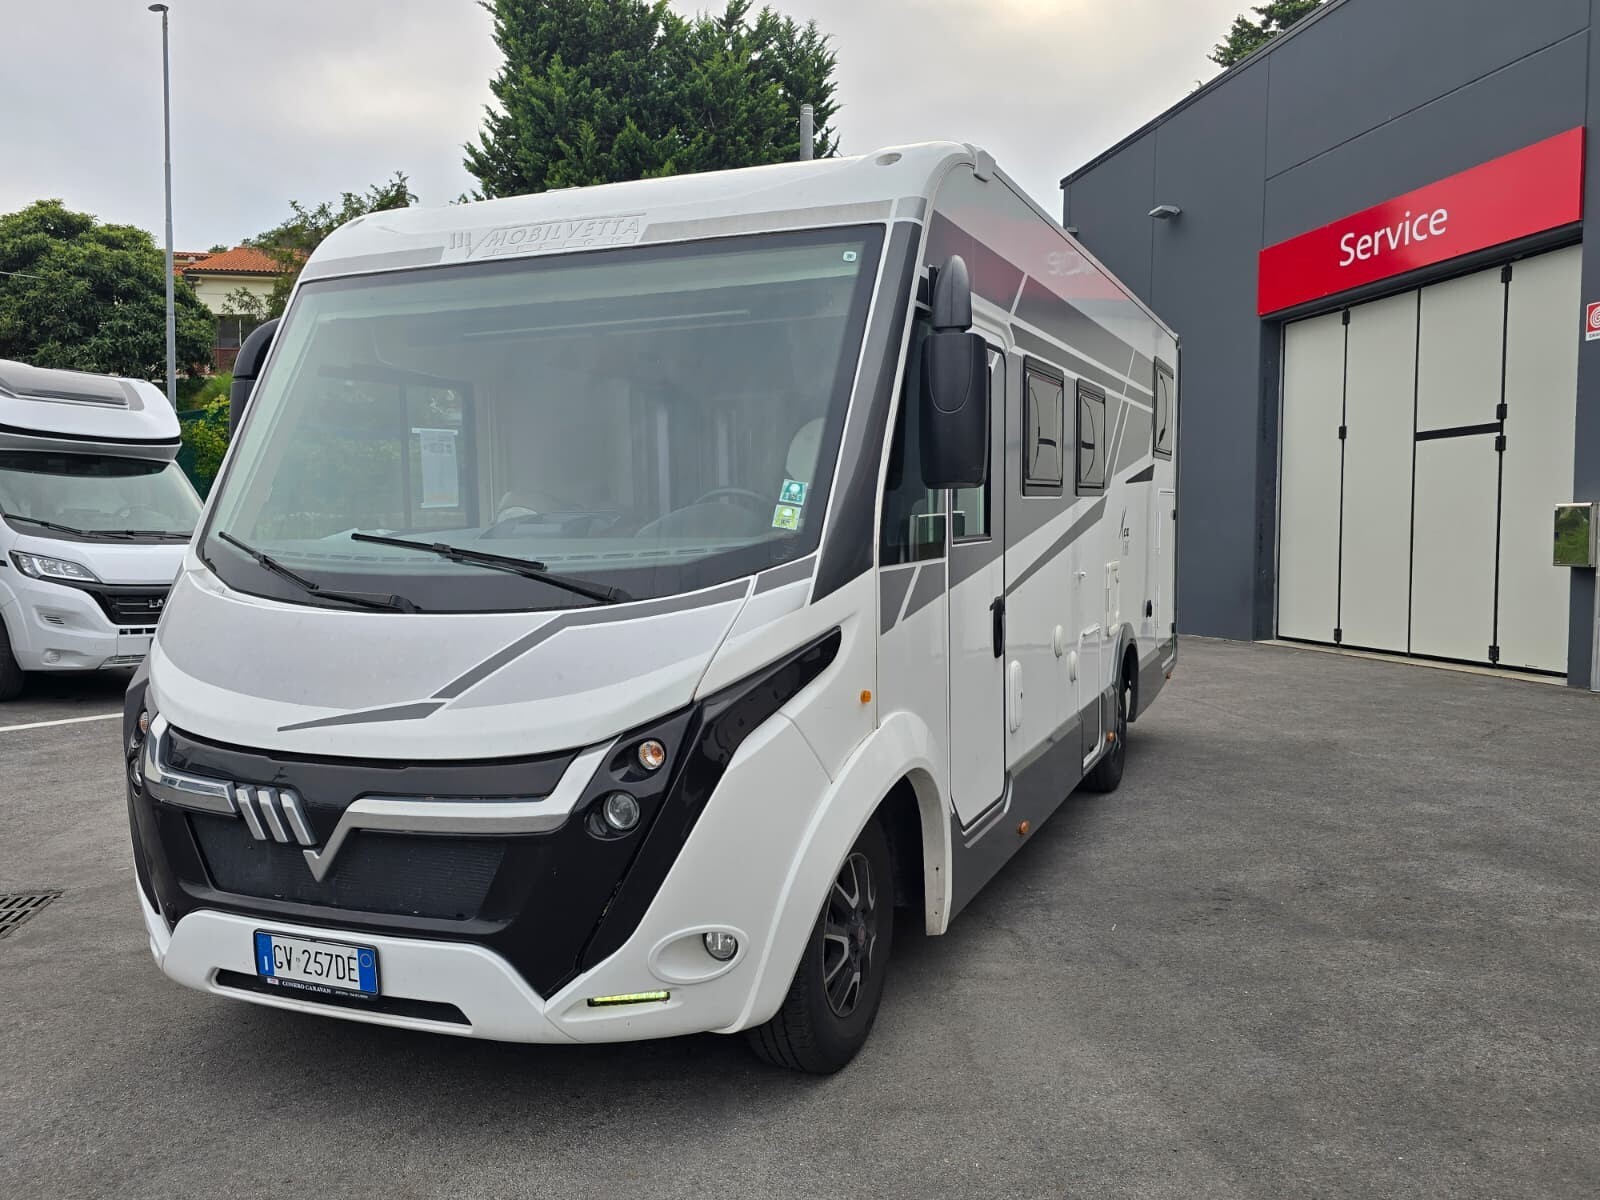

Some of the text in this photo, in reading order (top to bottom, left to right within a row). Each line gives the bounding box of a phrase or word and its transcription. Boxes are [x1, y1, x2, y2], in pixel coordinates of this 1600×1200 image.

[485, 218, 640, 249] MOBILVETTA
[1339, 208, 1448, 267] Service
[273, 944, 293, 972] GV
[301, 949, 359, 982] 257DE
